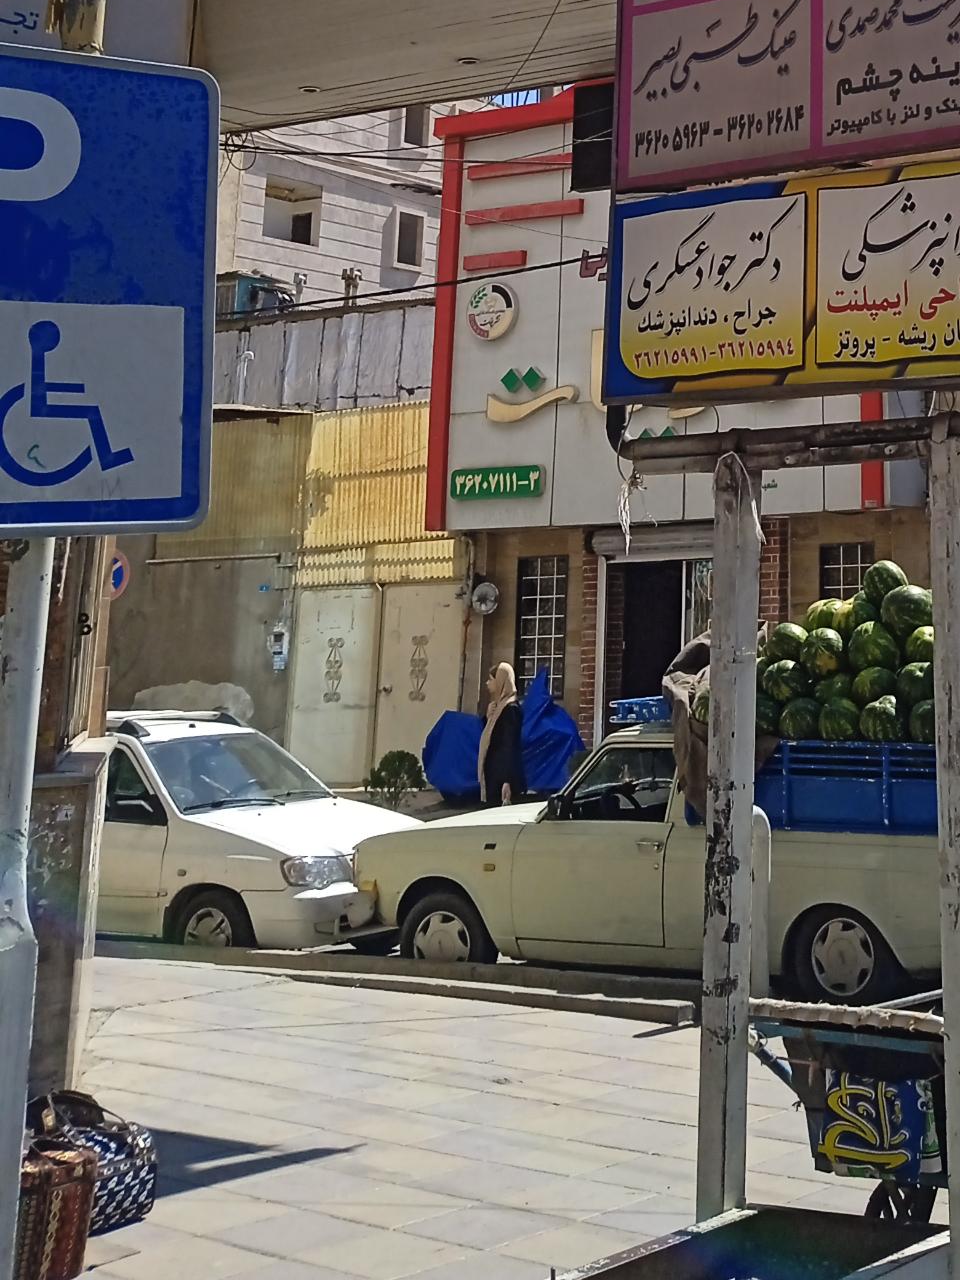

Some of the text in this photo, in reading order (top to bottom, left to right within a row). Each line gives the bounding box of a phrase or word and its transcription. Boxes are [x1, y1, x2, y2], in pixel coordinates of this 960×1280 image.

[670, 2, 759, 94] طبی
[826, 6, 880, 53] صمدی
[633, 35, 682, 102] بصیر
[836, 62, 904, 106] چشم
[826, 109, 882, 136] کامپیوتر
[886, 108, 897, 125] با
[900, 103, 920, 124] لنز
[924, 105, 933, 120] و
[730, 197, 799, 294] دکتر
[692, 253, 737, 292] جواد
[733, 297, 777, 335] جراح
[826, 279, 909, 321] ایمپلنت
[834, 329, 876, 359] پروتز
[898, 323, 937, 351] ریشه
